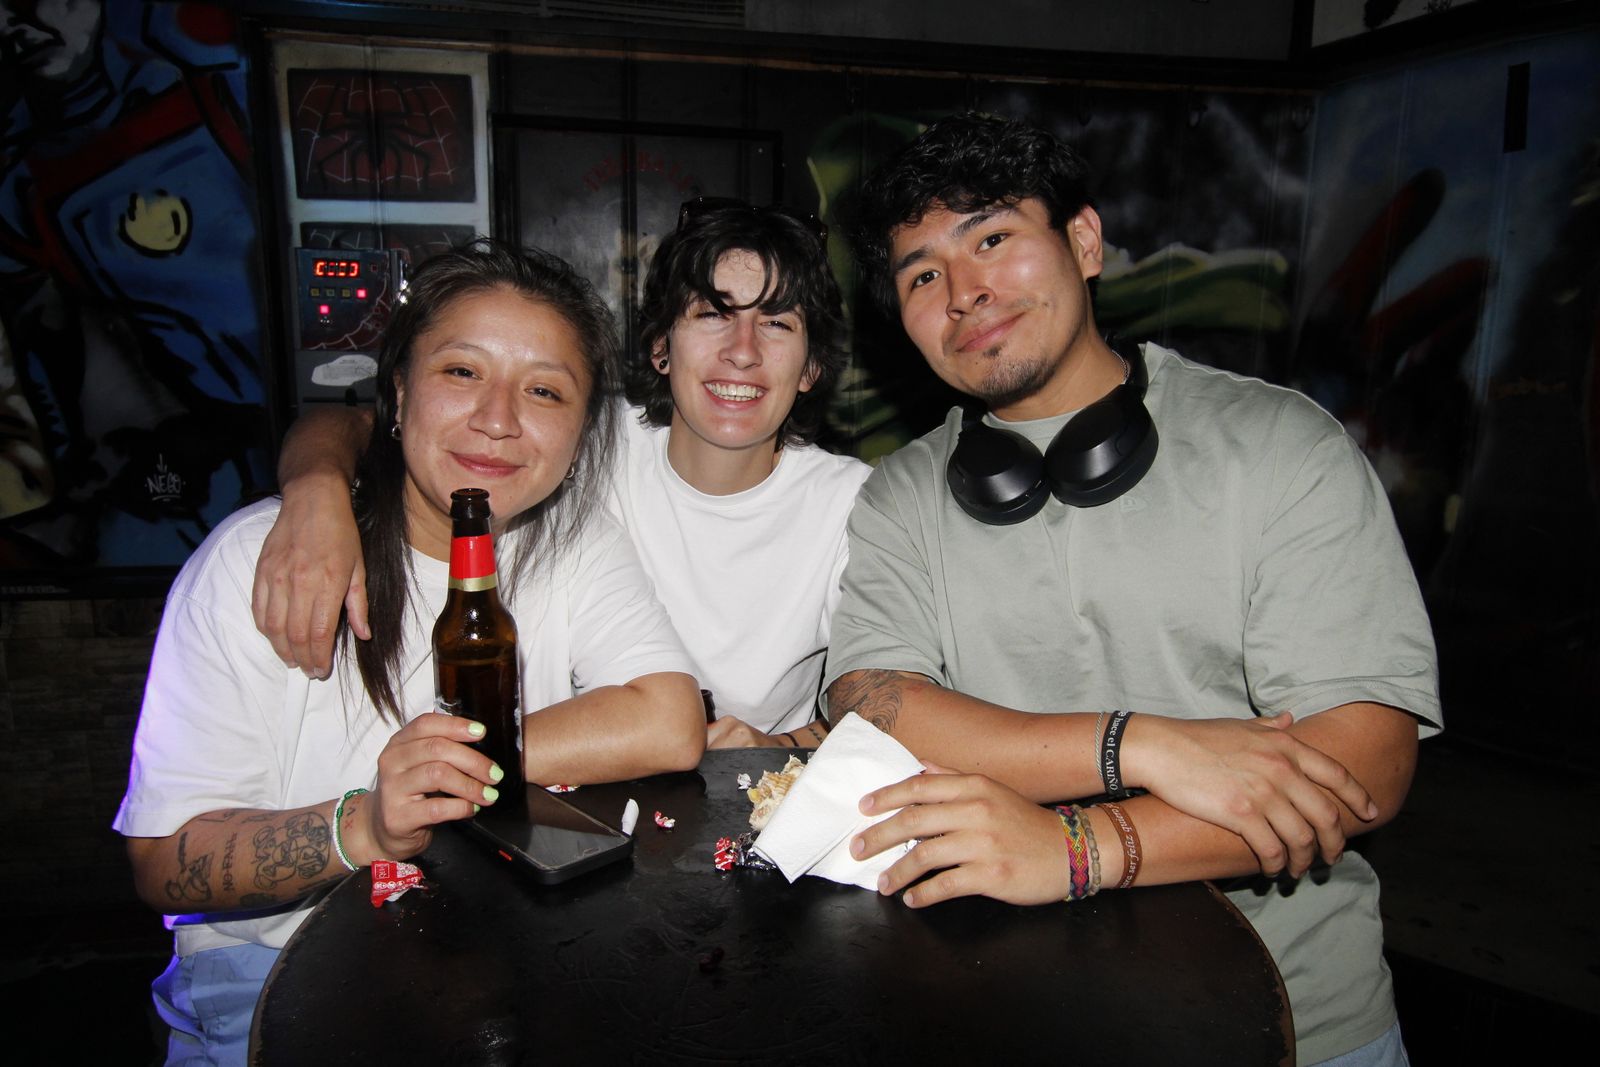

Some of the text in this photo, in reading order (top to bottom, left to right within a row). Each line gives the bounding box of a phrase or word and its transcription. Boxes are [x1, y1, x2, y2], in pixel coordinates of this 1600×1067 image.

[1109, 717, 1124, 736] hace
[1106, 737, 1116, 747] el
[1105, 749, 1119, 791] CARIÑO
[1111, 808, 1133, 833] quiero
[1125, 834, 1139, 861] feliz
[1128, 862, 1137, 874] ser
